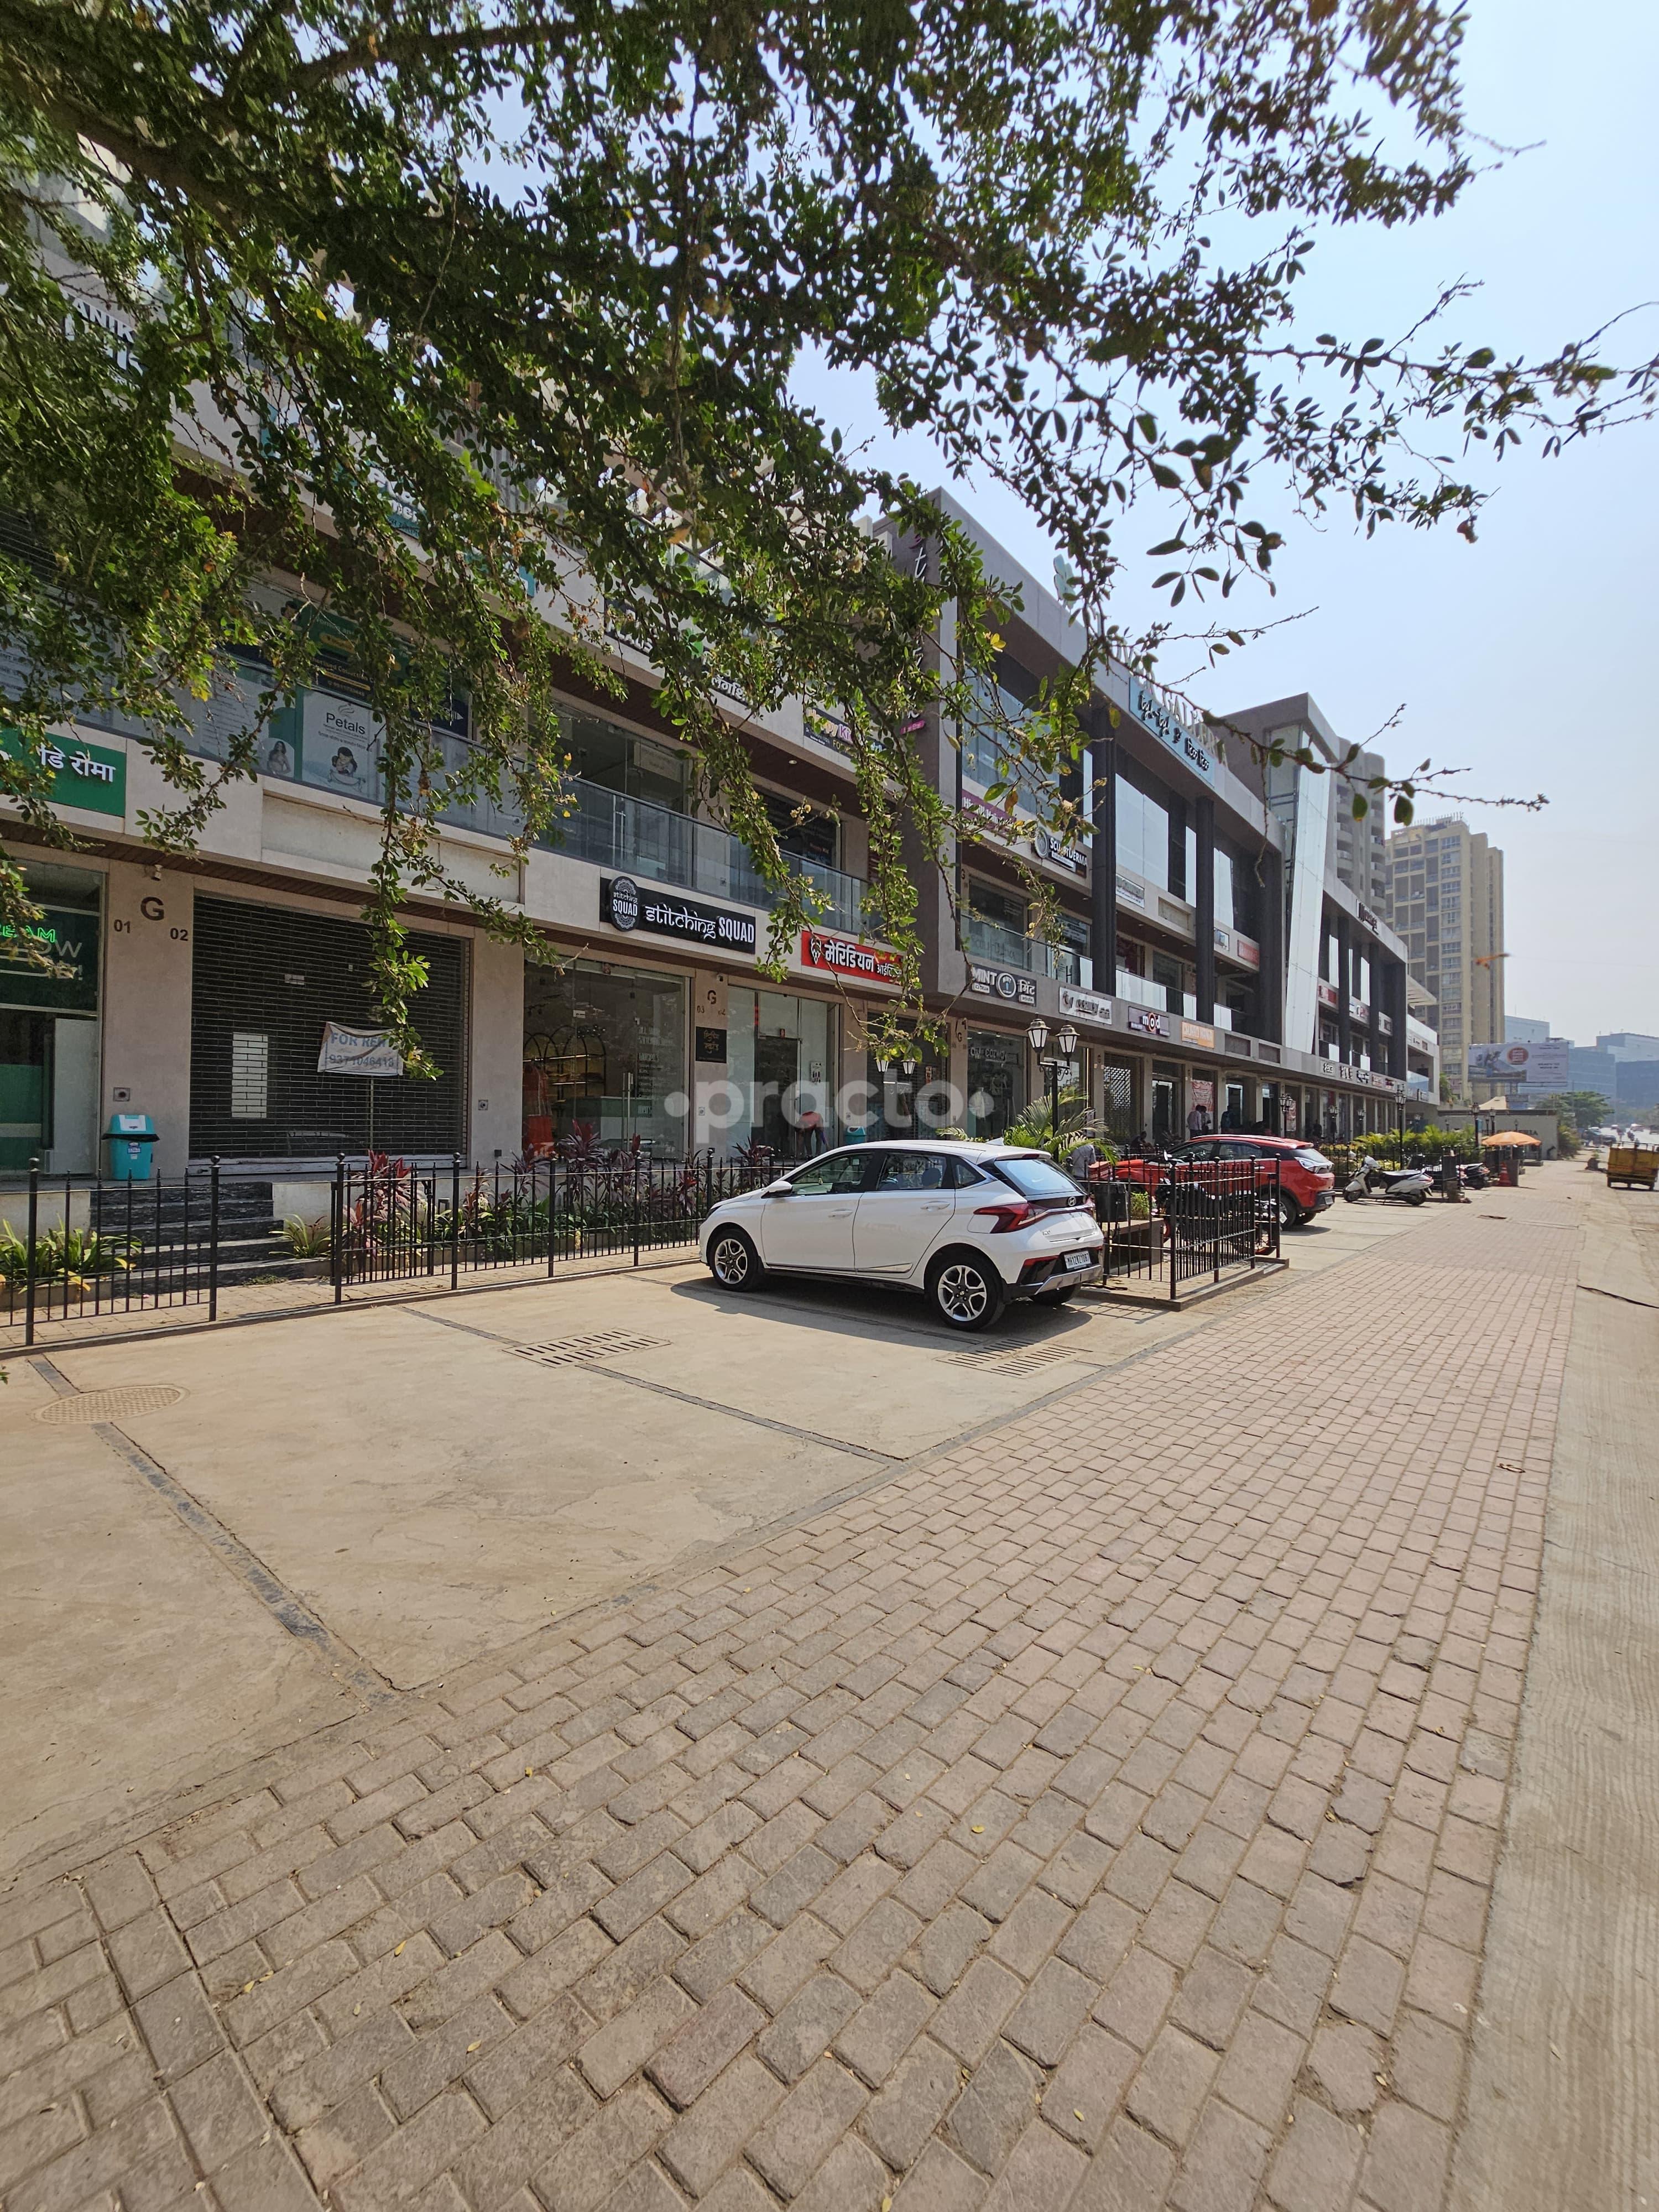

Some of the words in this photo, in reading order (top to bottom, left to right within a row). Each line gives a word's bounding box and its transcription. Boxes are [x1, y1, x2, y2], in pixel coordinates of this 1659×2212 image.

[326, 712, 366, 735] Petals
[806, 708, 838, 737] Hpy
[69, 750, 116, 782] रोमा
[1050, 837, 1088, 867] SCUPTDERMA
[140, 896, 165, 921] G
[613, 891, 638, 905] stitching
[613, 899, 638, 917] SQUAD
[113, 919, 131, 934] 01
[170, 927, 189, 941] 02
[645, 904, 717, 940] stitching
[718, 916, 755, 944] SQUAD
[824, 940, 875, 973] मेरिडियन
[971, 967, 998, 985] MINT
[707, 989, 717, 1005] G
[697, 1005, 705, 1014] 03
[1142, 1014, 1161, 1030] mod
[331, 1031, 358, 1046] FOR
